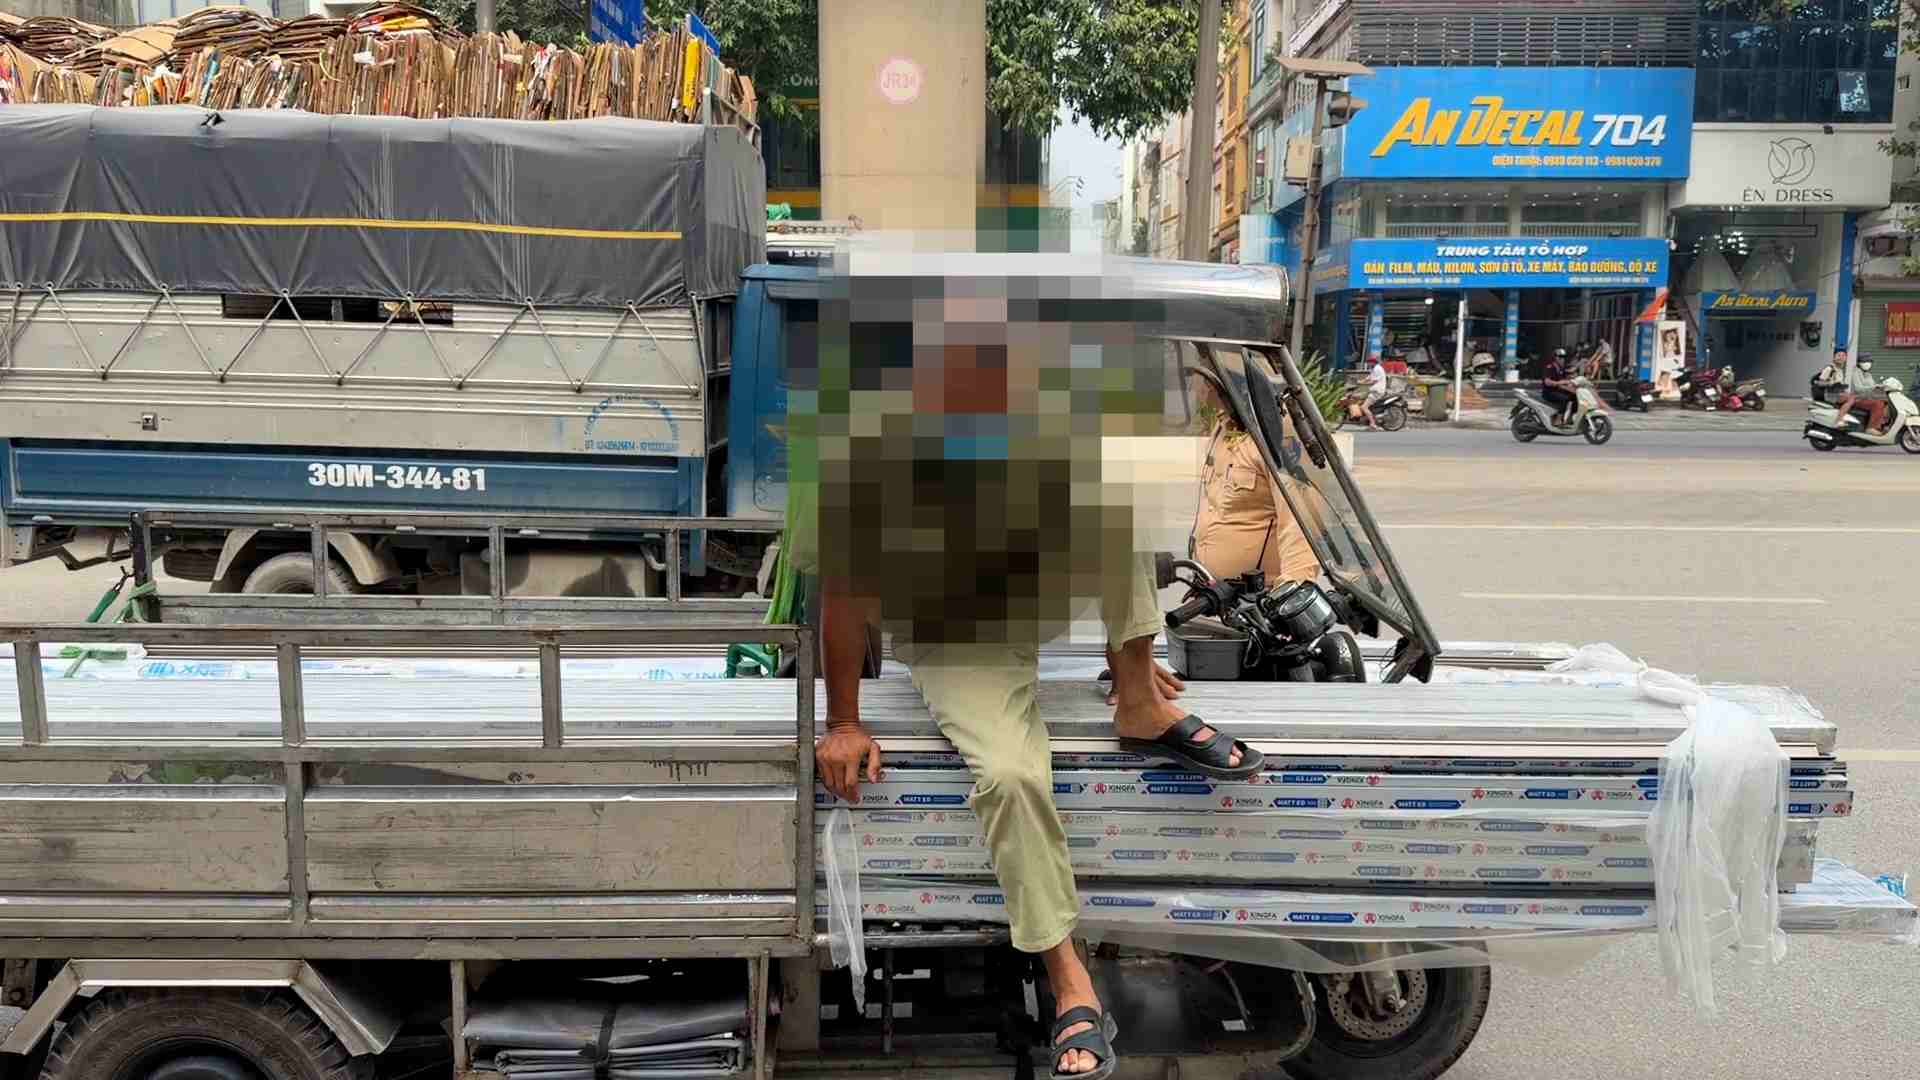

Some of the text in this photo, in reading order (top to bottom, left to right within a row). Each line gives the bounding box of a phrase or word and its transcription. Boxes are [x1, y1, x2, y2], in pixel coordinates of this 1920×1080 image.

[1369, 95, 1667, 157] AN DECAL 704
[1776, 188, 1834, 202] DRESS
[1436, 246, 1490, 257] TRUNG
[1493, 243, 1526, 257] TÂM
[1529, 239, 1550, 256] TỔ
